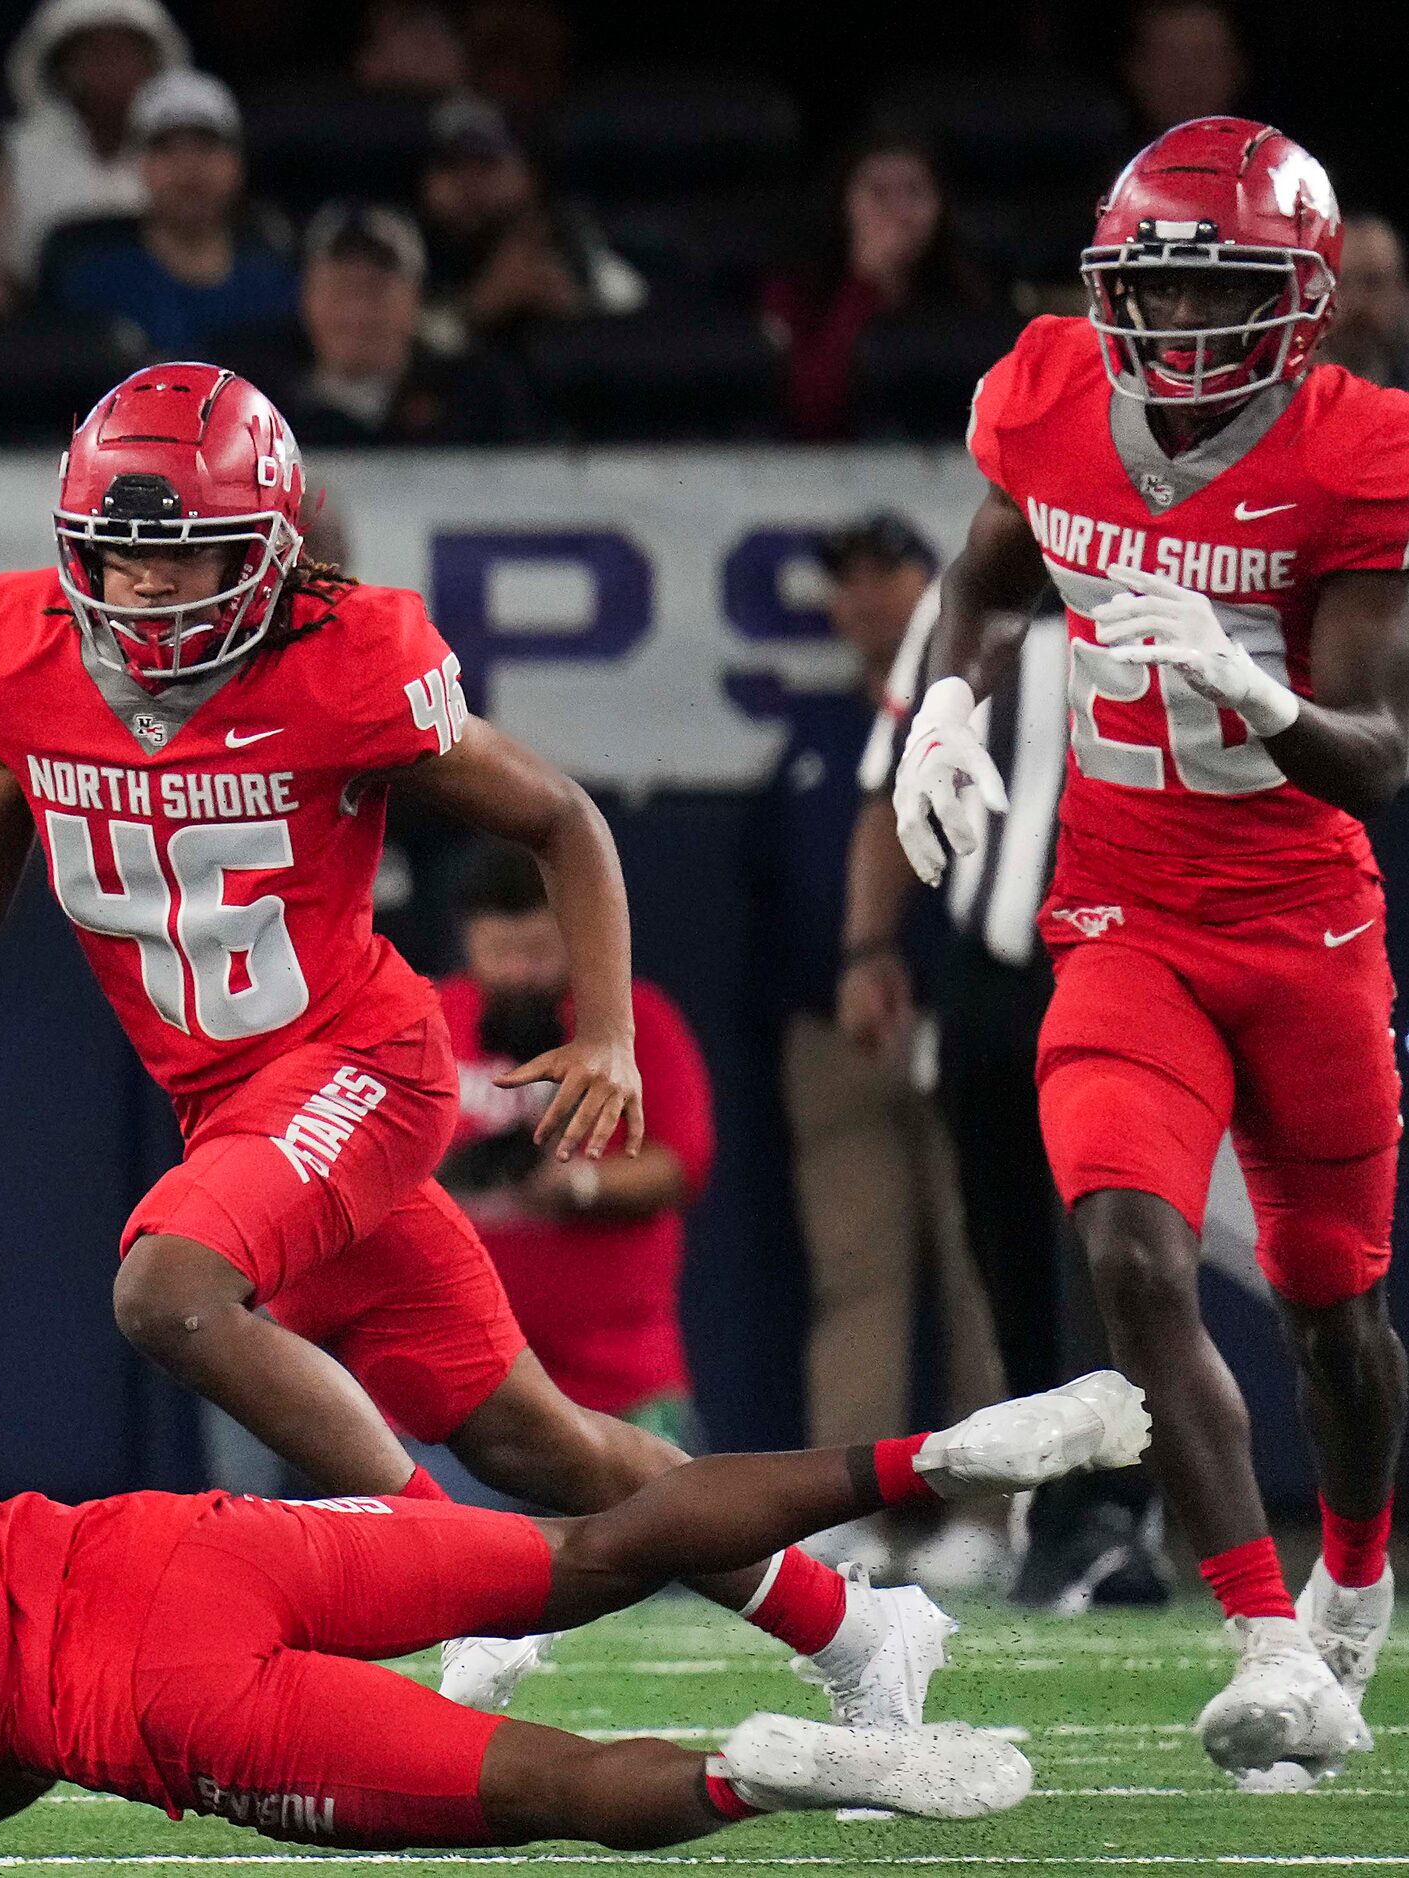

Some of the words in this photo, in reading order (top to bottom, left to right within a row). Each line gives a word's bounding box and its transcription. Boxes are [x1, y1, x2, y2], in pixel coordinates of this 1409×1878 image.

[1027, 496, 1147, 571] NORTH
[1155, 536, 1298, 595] SHORE
[403, 651, 469, 757] 46
[26, 754, 152, 816] NORTH
[160, 770, 300, 820] SHORE
[45, 809, 311, 1042] 46
